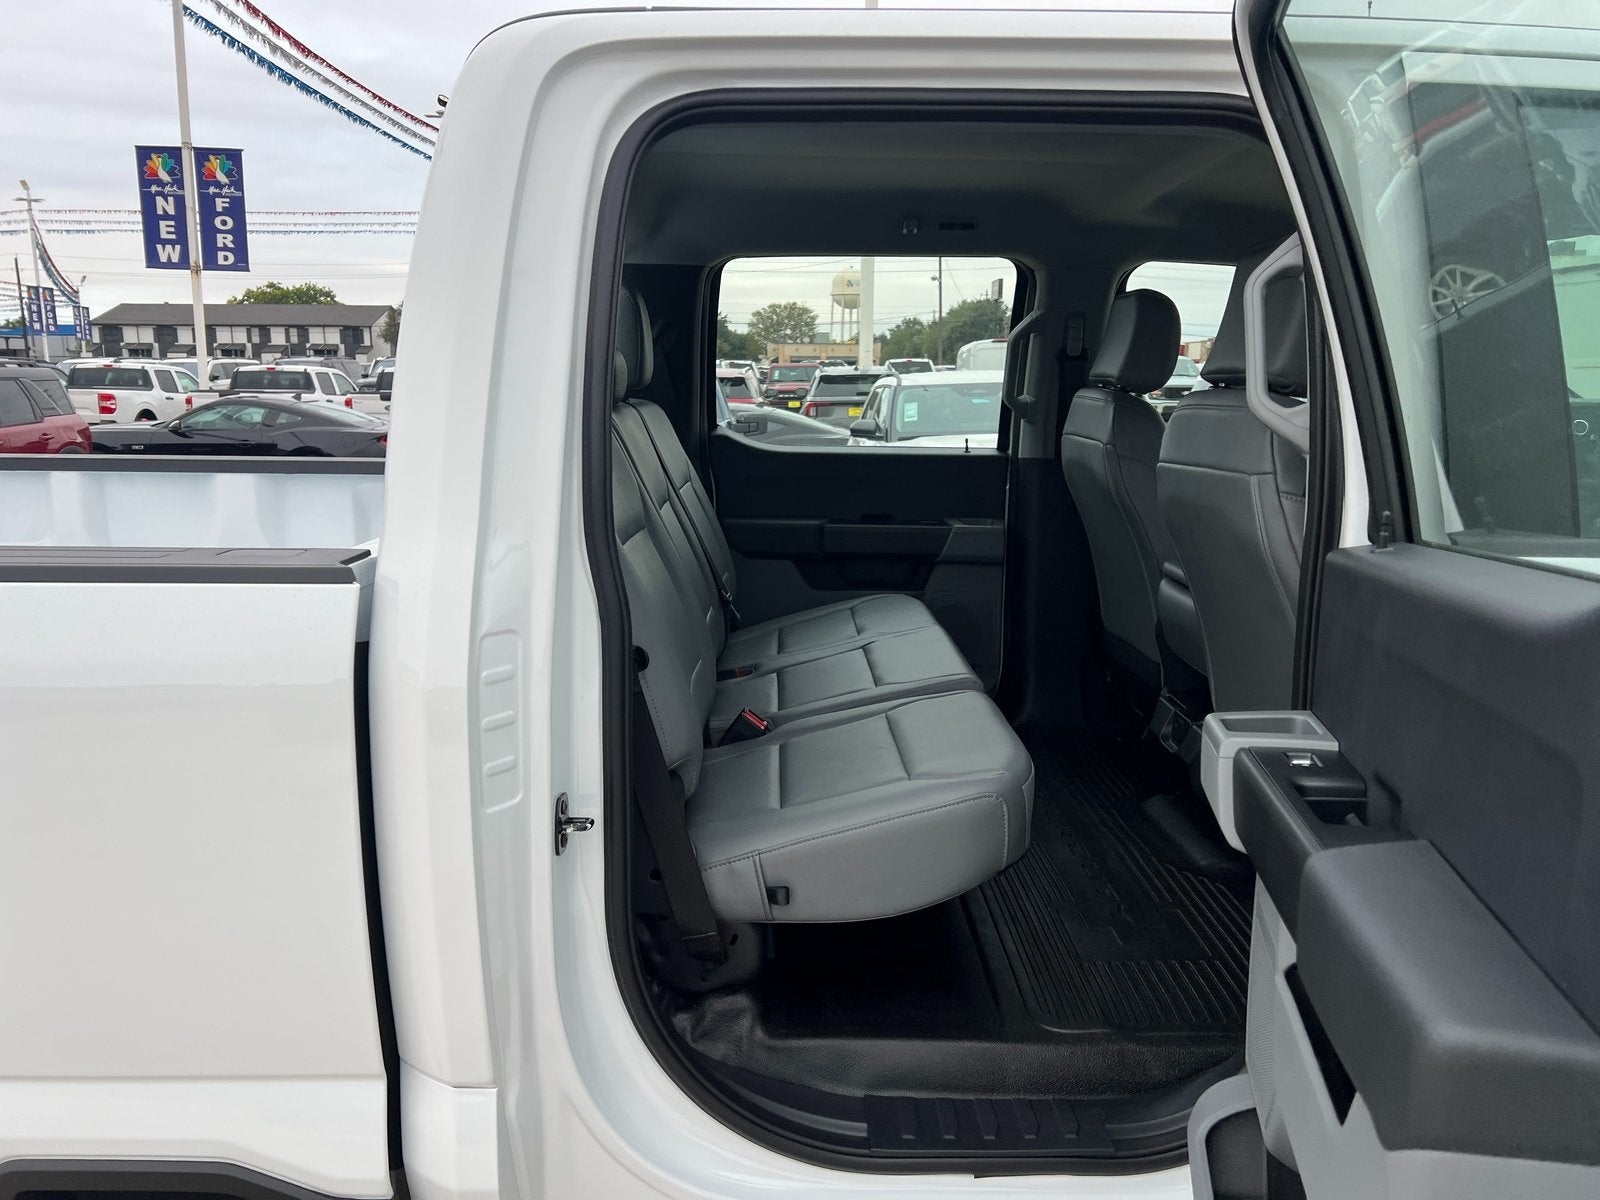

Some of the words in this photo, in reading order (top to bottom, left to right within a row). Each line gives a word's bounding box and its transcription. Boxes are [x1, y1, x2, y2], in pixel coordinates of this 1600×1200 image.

[155, 196, 181, 263] NEW
[214, 198, 235, 265] FORD
[30, 304, 40, 330] NEW
[46, 305, 55, 331] FORD
